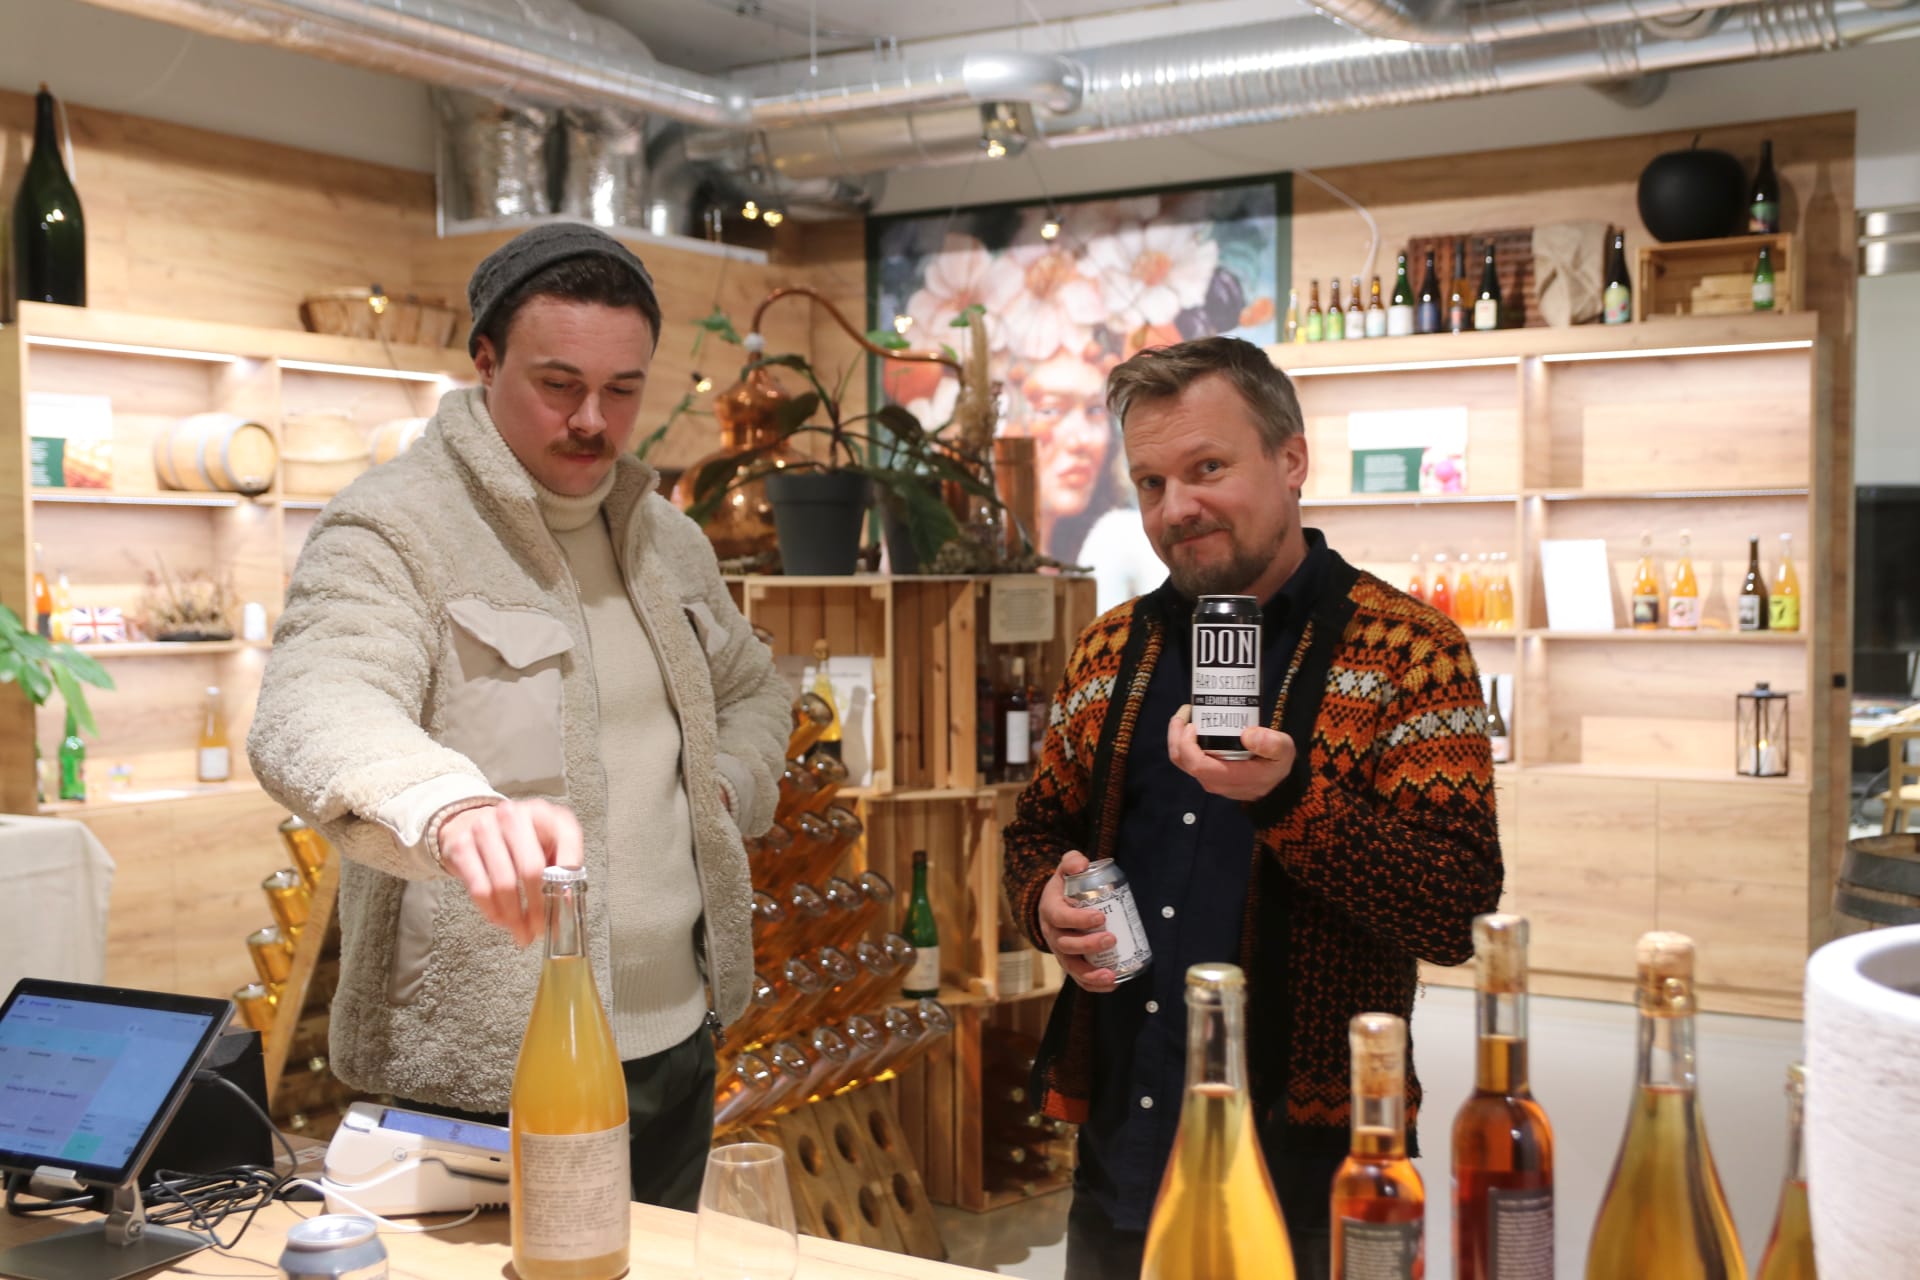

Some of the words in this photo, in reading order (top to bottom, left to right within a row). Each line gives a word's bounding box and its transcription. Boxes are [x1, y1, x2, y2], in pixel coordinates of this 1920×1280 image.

[1199, 629, 1255, 665] DON
[1196, 673, 1217, 689] HARD
[1219, 674, 1256, 689] SELTZER
[1201, 712, 1248, 729] PREMIUM
